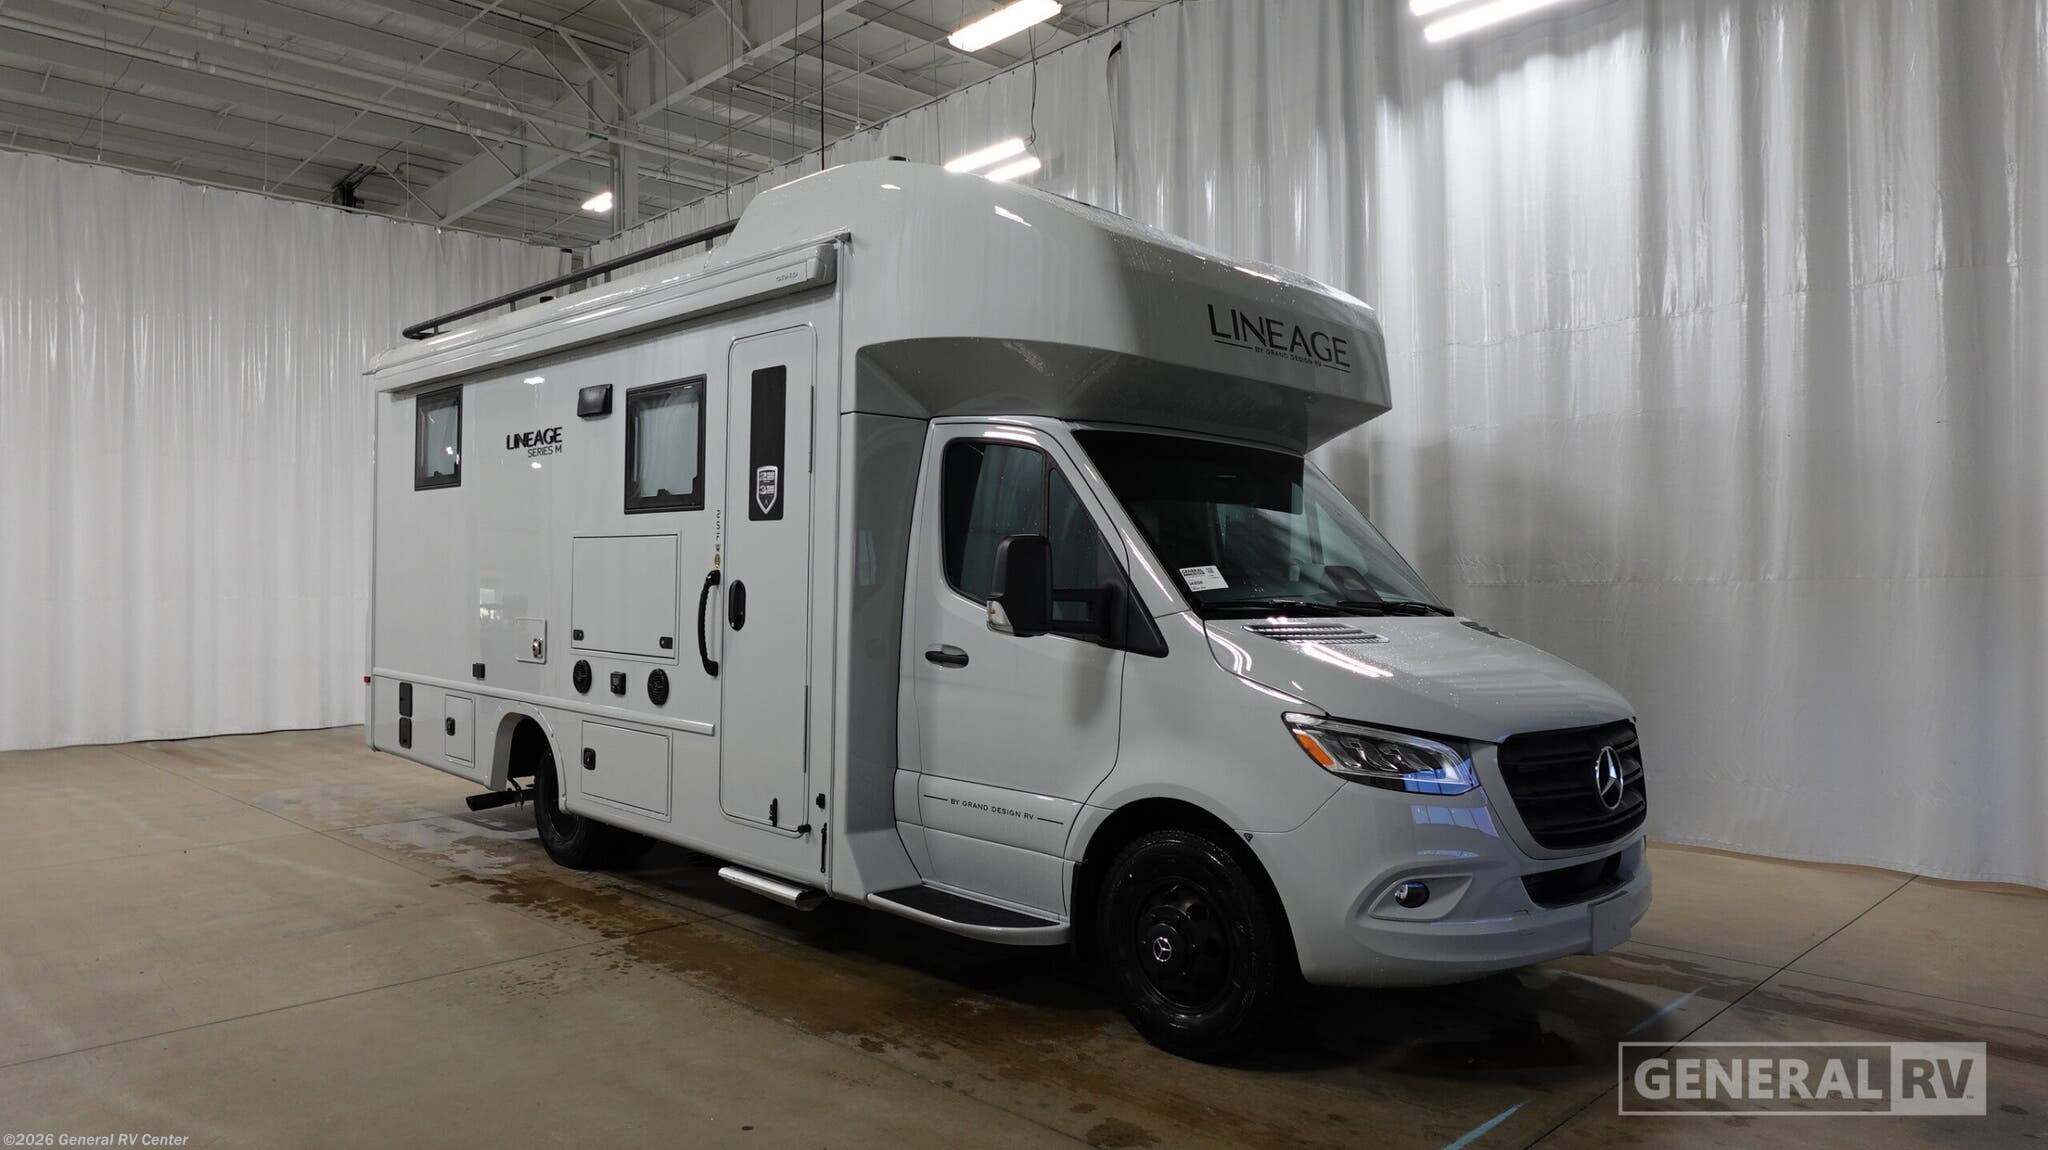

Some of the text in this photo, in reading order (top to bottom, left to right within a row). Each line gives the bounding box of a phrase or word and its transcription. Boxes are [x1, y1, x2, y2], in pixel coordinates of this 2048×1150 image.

[1207, 303, 1351, 368] LINEAGE
[506, 426, 563, 450] LINEAGE
[527, 444, 562, 458] SERIES M
[950, 797, 1034, 821] BY GRAND DESIGN RV
